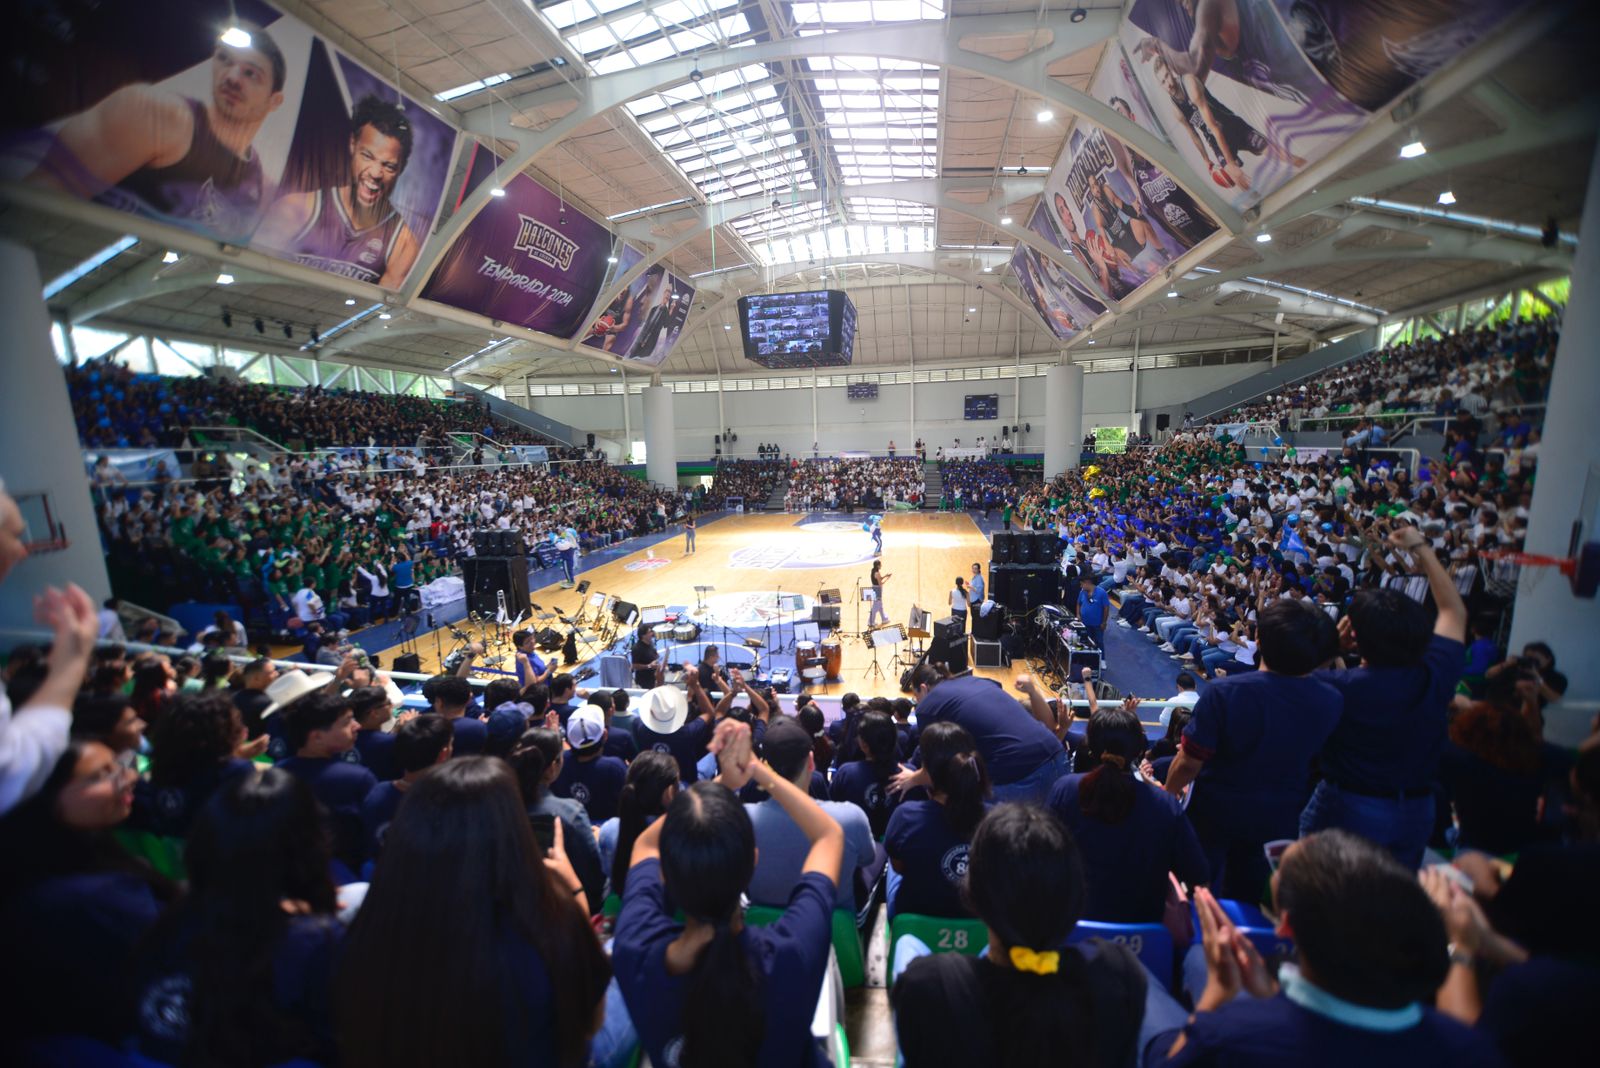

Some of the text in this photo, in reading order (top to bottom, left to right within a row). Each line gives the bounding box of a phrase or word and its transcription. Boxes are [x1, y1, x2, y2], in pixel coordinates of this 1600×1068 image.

[517, 218, 576, 268] HALCONES
[478, 255, 574, 307] TEMPORADA 2024
[938, 928, 968, 949] 28
